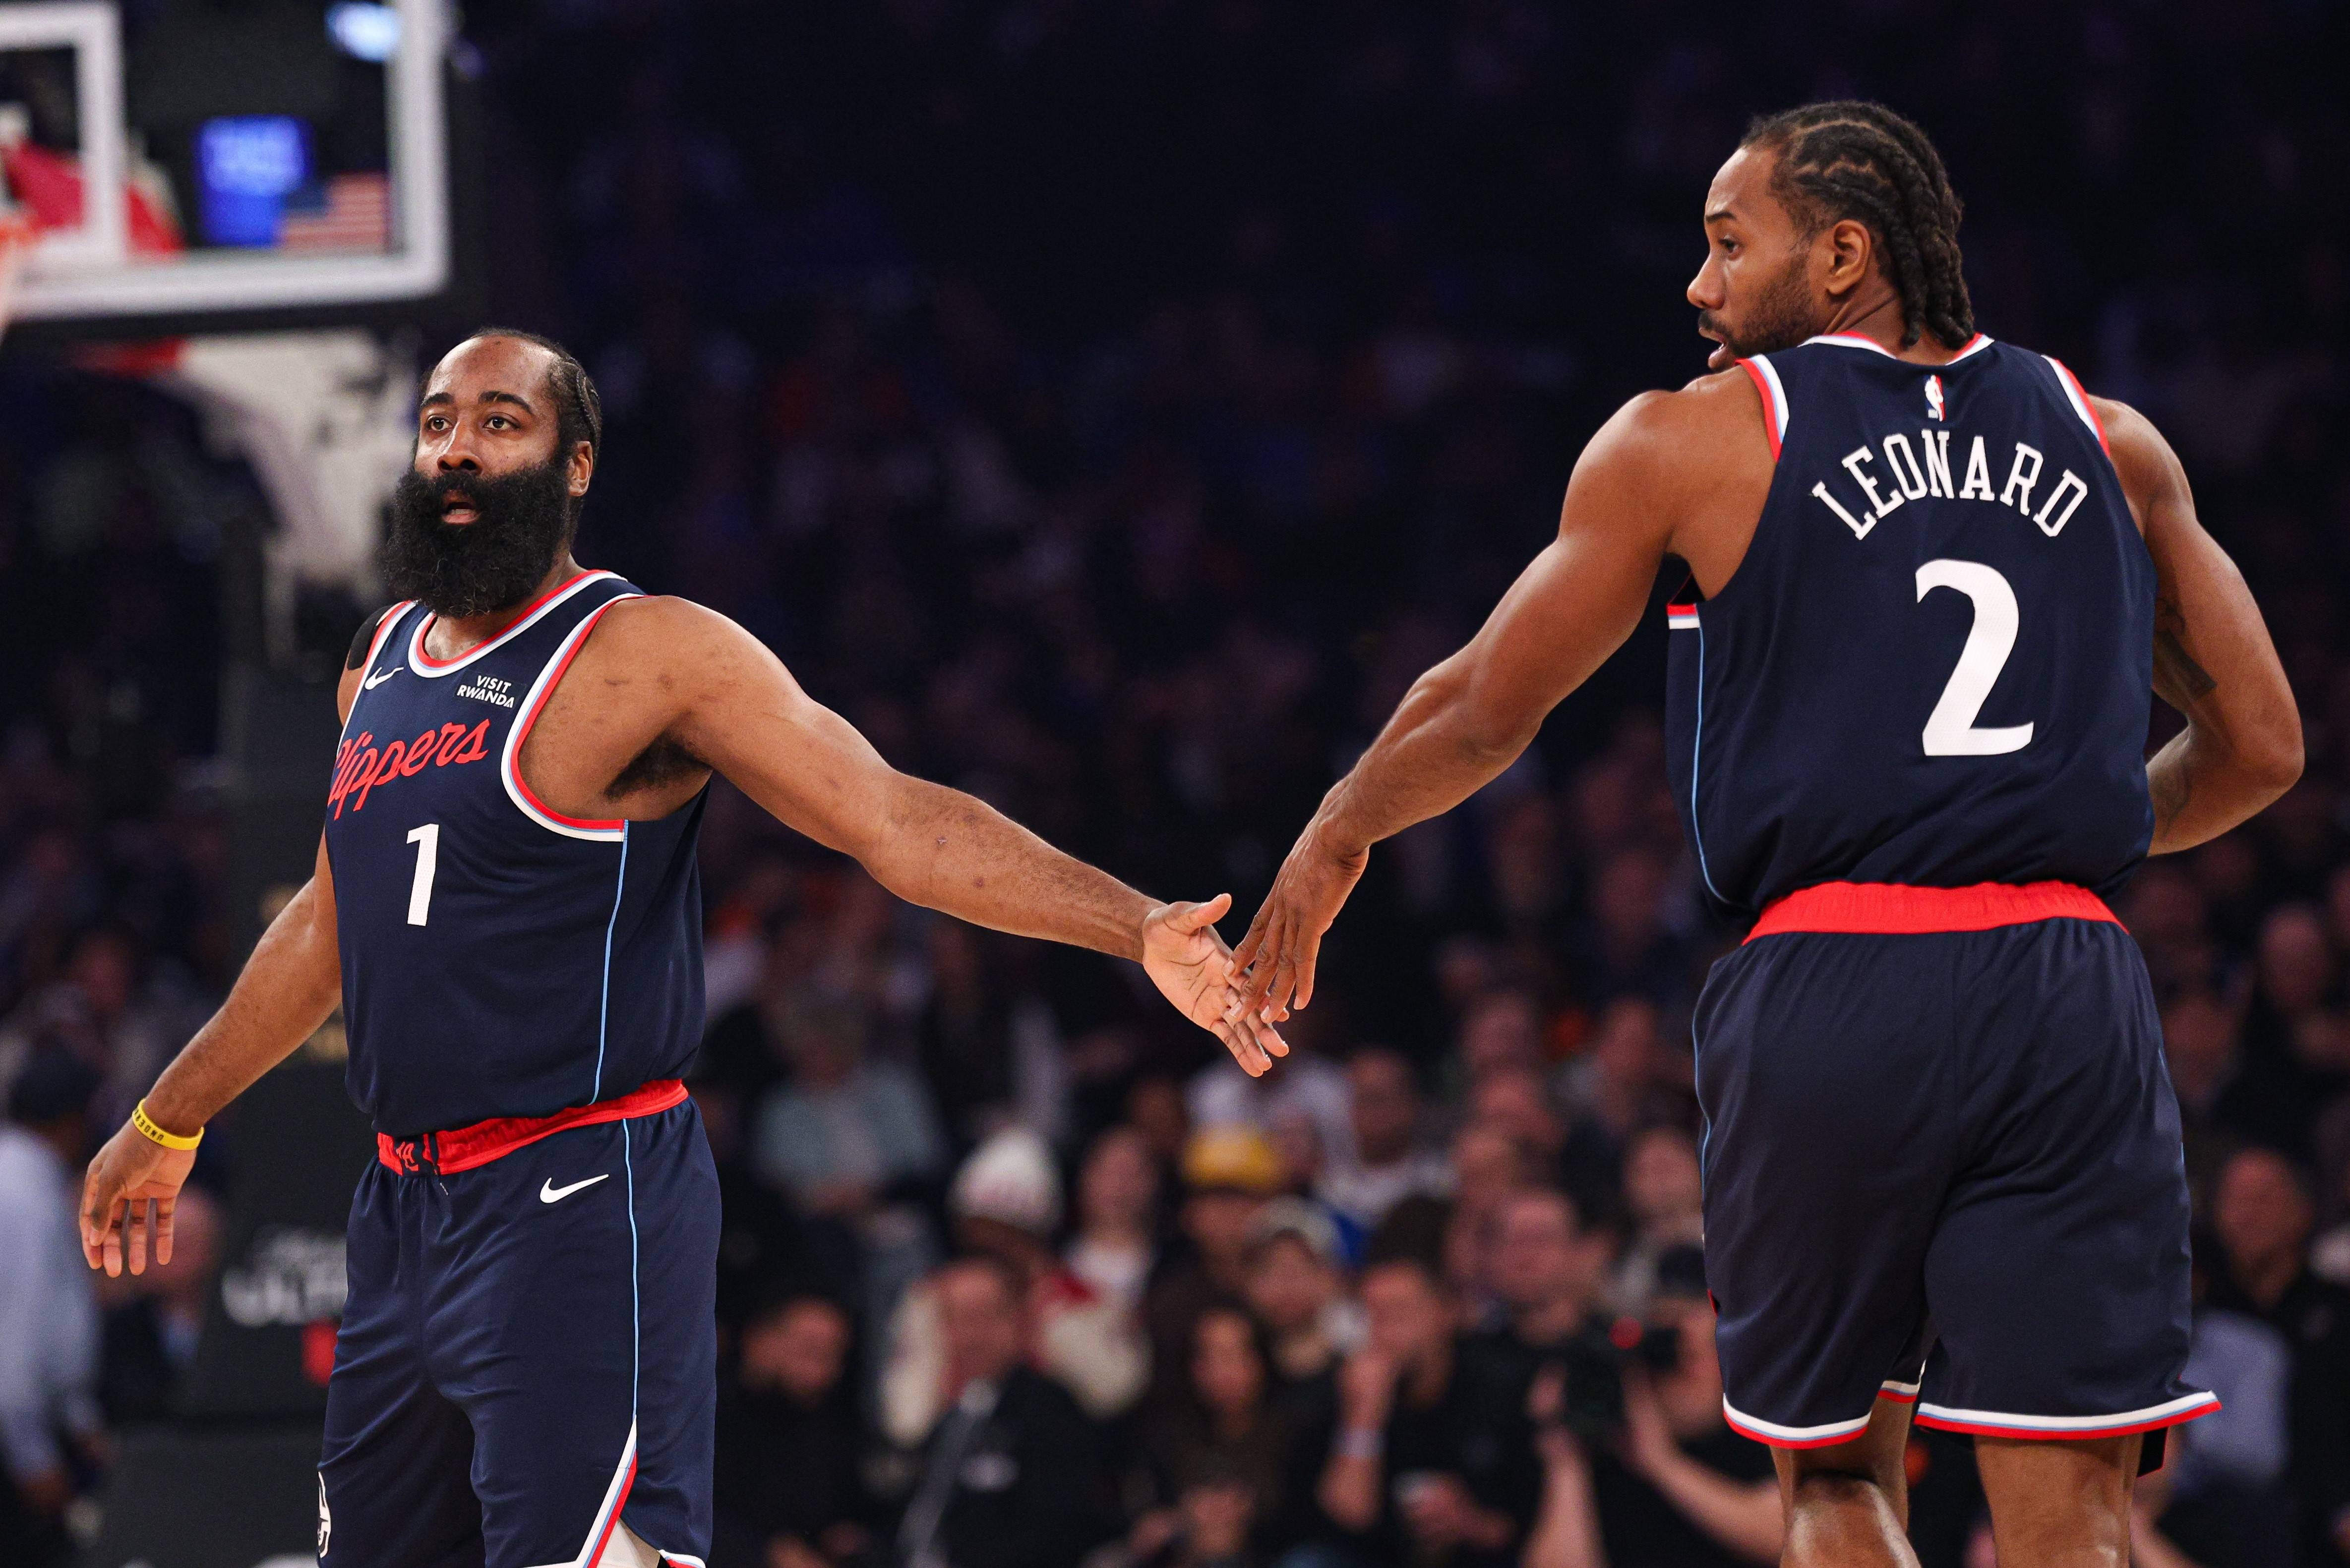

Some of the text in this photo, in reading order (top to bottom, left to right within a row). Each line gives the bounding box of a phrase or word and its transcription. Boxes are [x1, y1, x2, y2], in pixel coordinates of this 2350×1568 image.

[1811, 429, 2088, 540] LEONARD
[457, 685, 515, 708] RWANDA
[477, 675, 512, 694] VISIT
[1915, 559, 2034, 755] 2
[328, 718, 490, 820] lippers
[406, 823, 439, 927] 1
